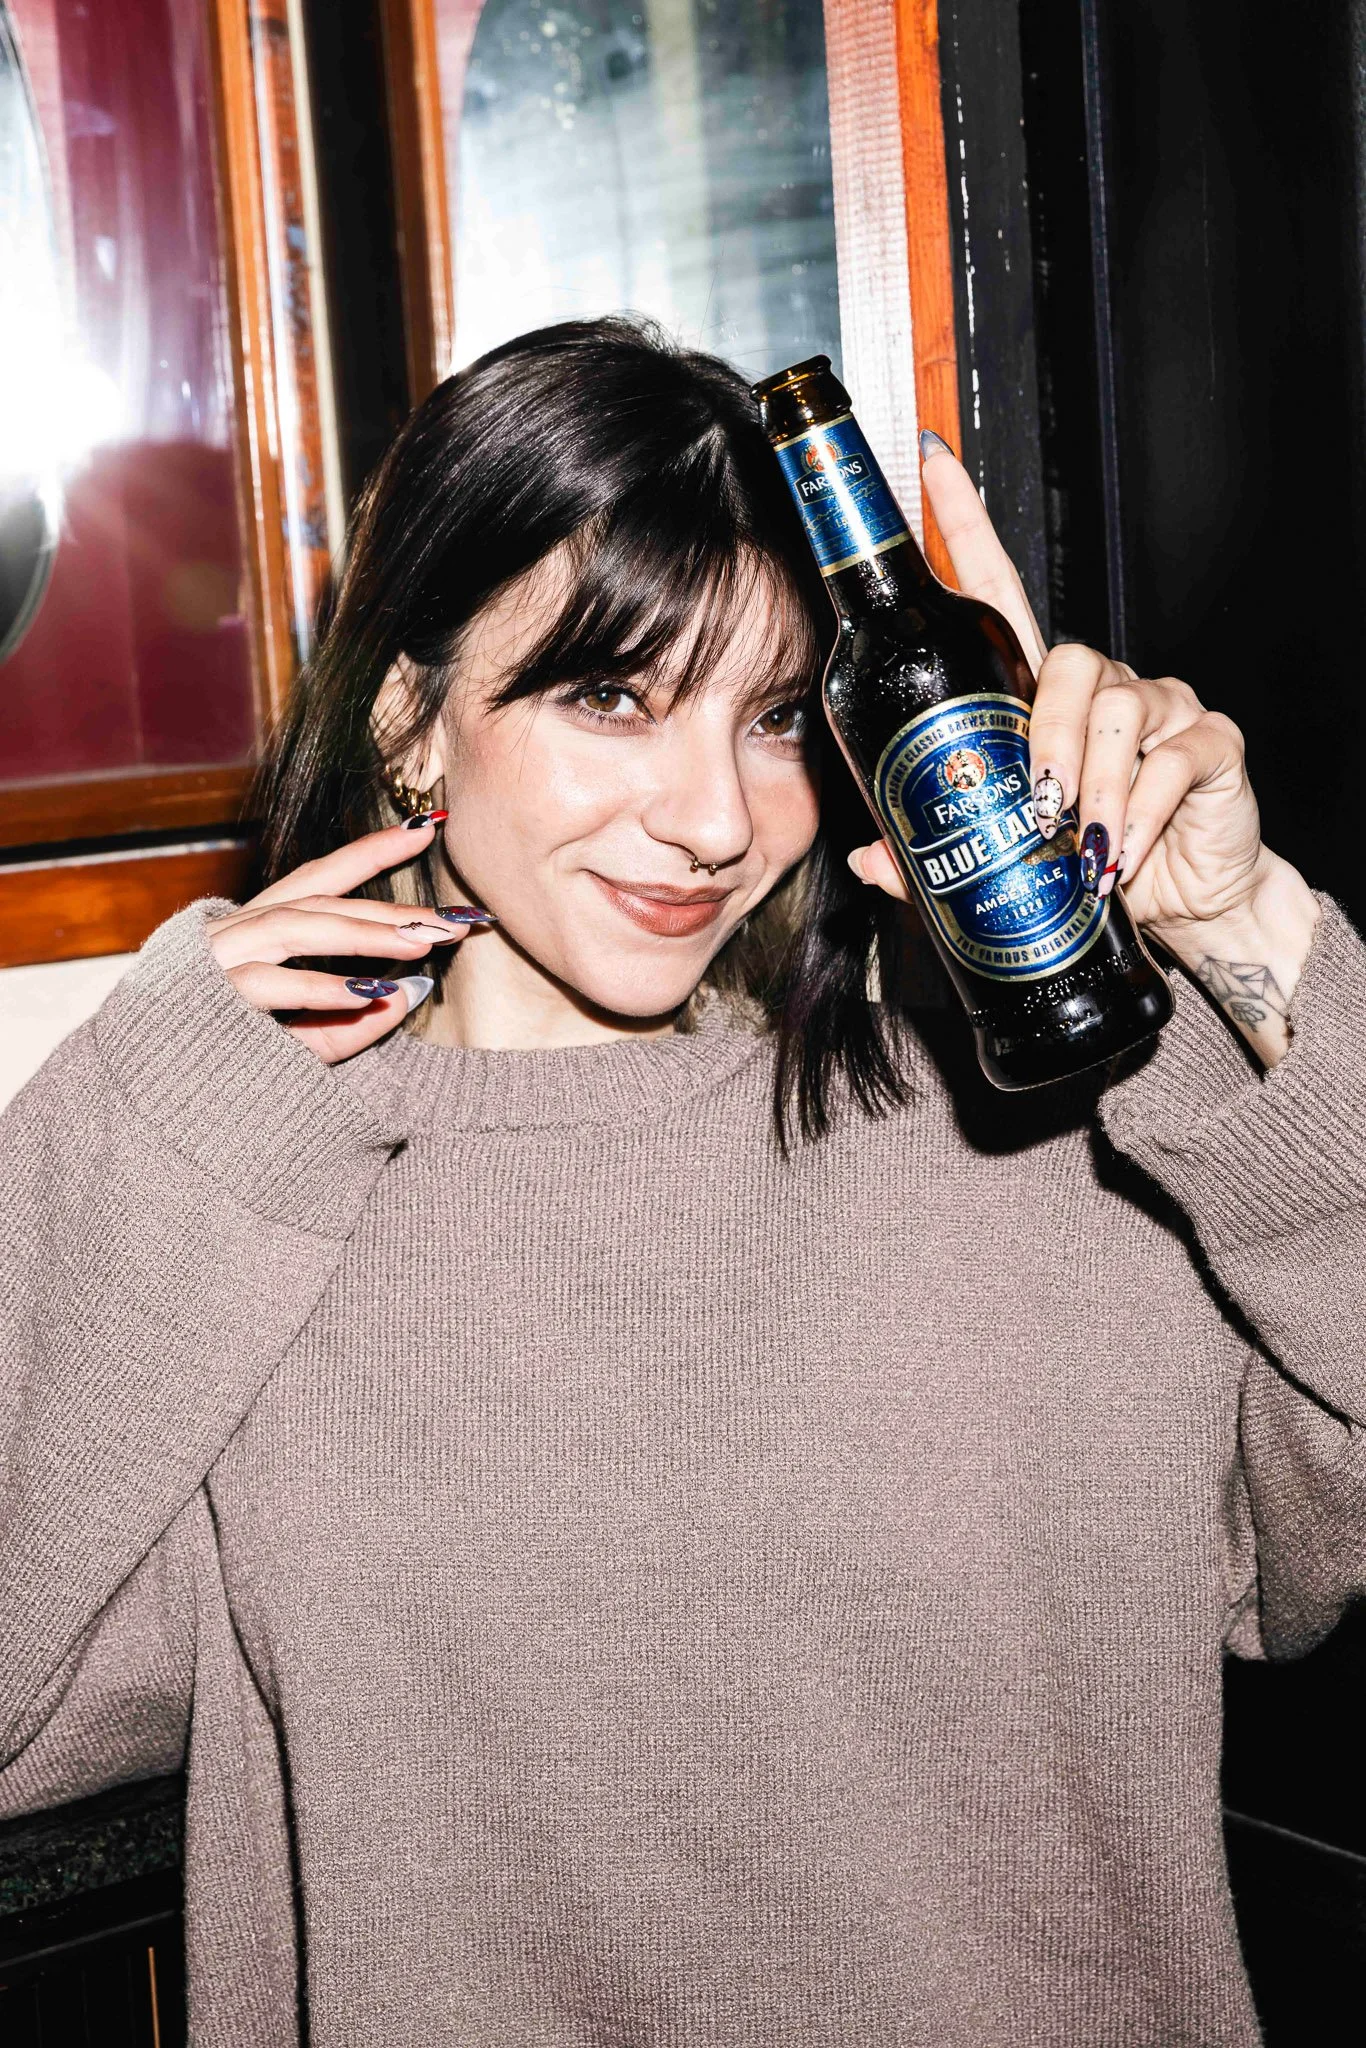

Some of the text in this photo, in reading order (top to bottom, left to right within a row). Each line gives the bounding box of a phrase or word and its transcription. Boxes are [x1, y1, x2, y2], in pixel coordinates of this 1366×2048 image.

[800, 460, 863, 497] FARONS
[904, 729, 945, 764] CLASSIC
[948, 714, 986, 734] BREWS
[989, 713, 1019, 730] SINCE
[934, 774, 1022, 825] FARSONS
[923, 801, 1039, 886] BLUE LAB
[976, 867, 1064, 915] AMBER ALE
[979, 948, 1029, 964] FAMOUS
[1033, 918, 1085, 957] ORIGINAL
